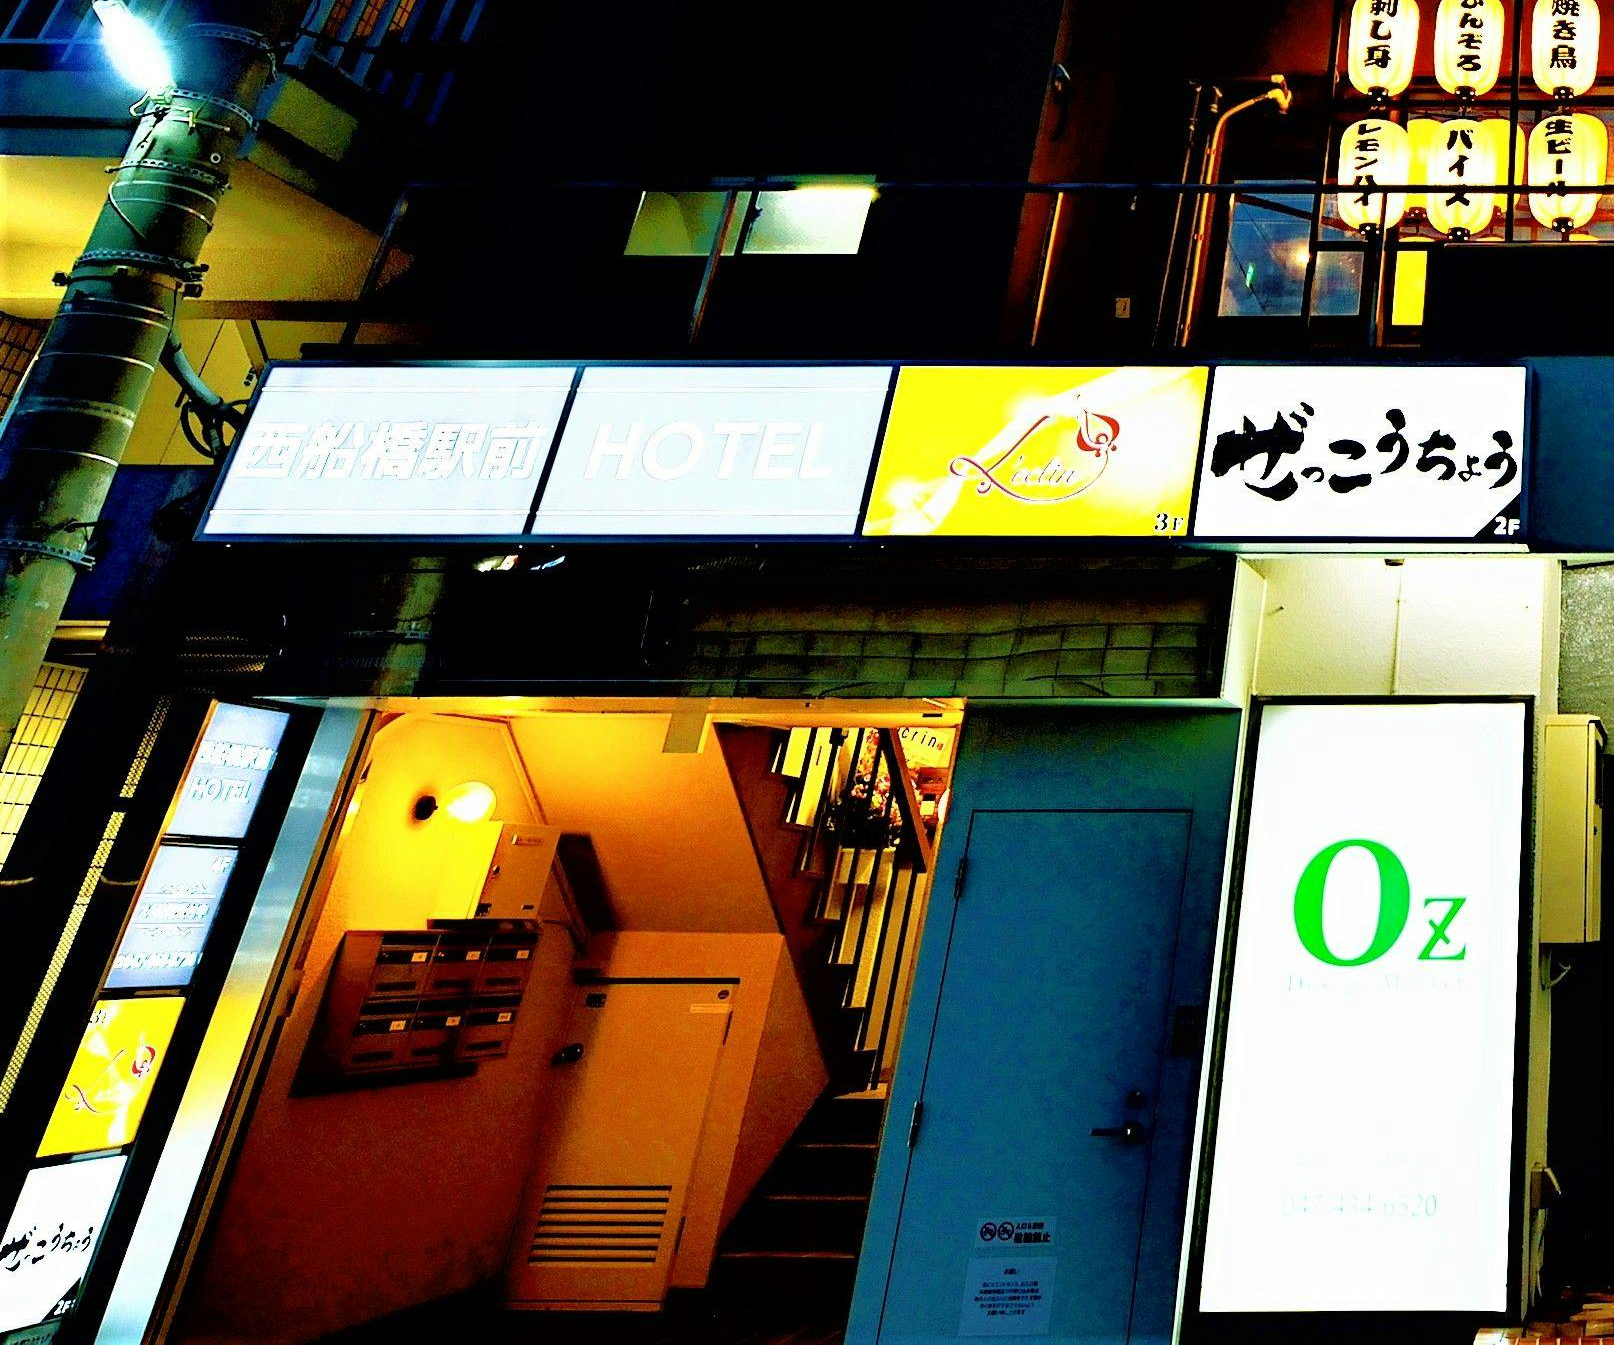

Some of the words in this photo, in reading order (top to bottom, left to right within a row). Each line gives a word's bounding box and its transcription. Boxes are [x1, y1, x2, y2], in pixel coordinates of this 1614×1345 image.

[1353, 123, 1382, 207] レモンハイ
[1445, 129, 1474, 207] バイス
[1544, 118, 1574, 198] 生ビール
[233, 419, 549, 482] 西船橋駅前
[583, 420, 838, 482] HOTEL
[1210, 400, 1519, 503] ぜっこうちょう
[1493, 515, 1521, 536] 2F
[1293, 838, 1468, 968] Oz
